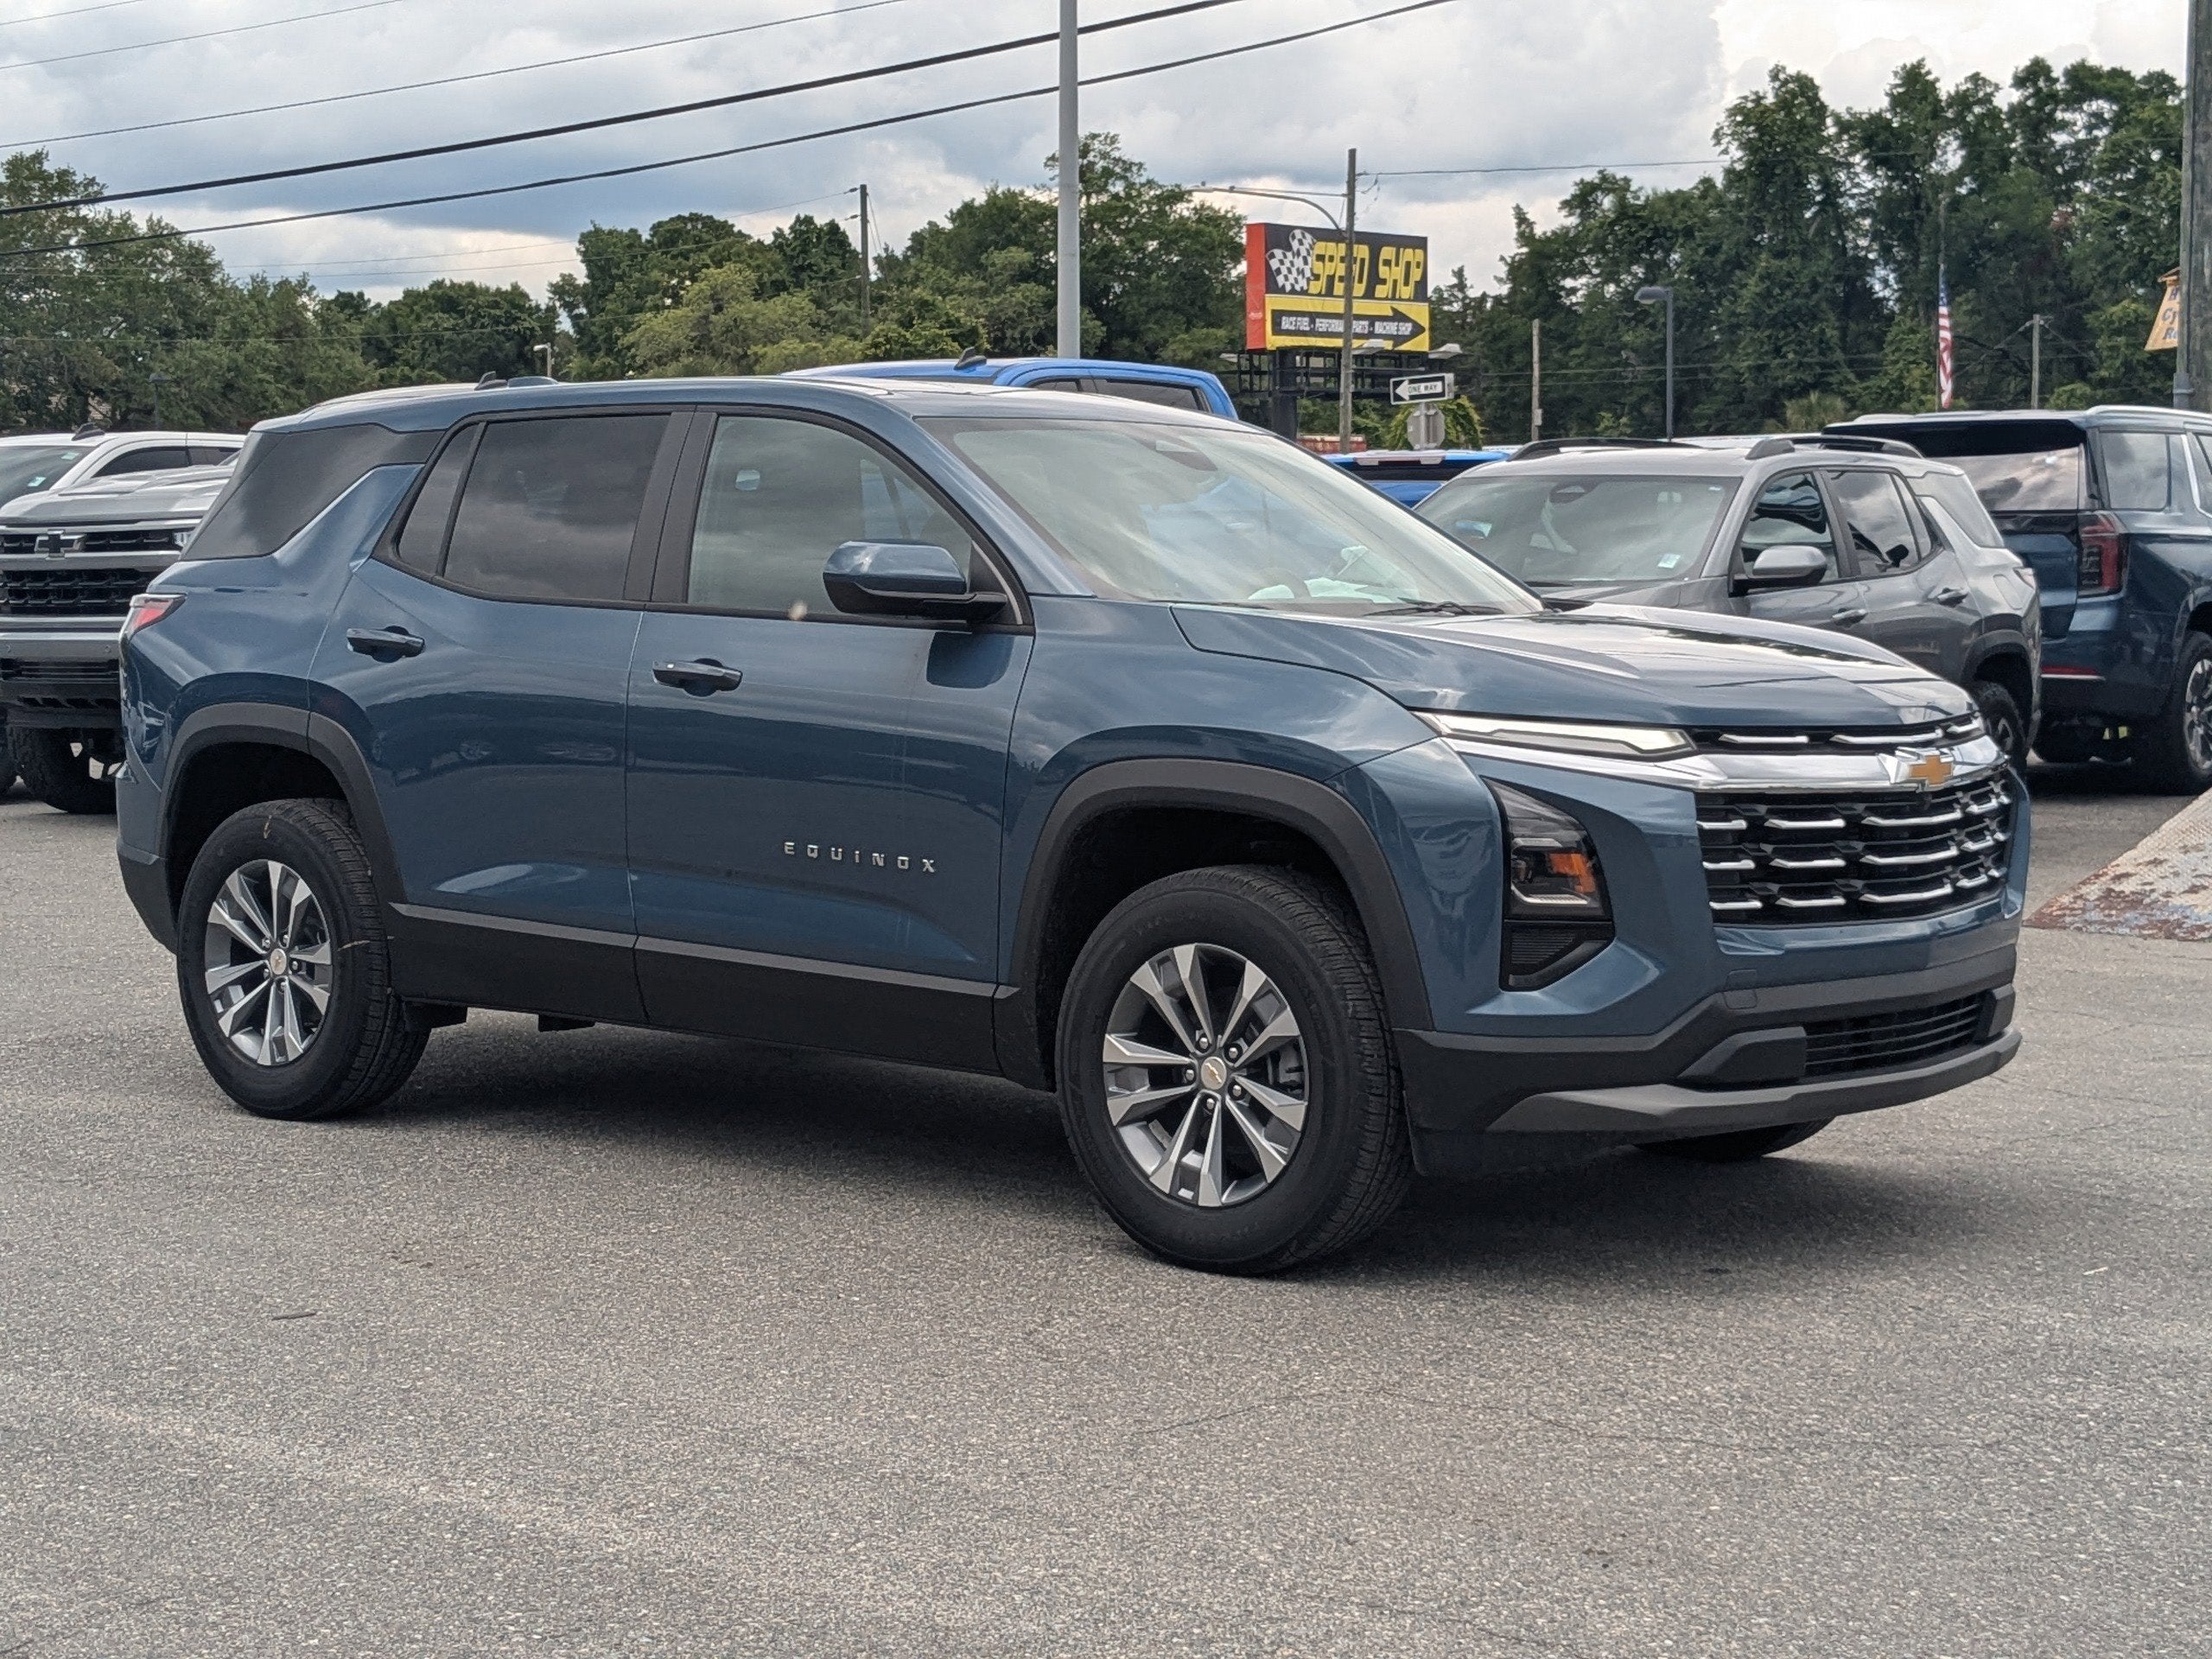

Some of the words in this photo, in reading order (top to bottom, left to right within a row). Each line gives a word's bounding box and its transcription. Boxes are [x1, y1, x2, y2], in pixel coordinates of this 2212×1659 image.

[1375, 246, 1424, 299] SHOP
[1409, 385, 1421, 393] ONE
[1423, 383, 1438, 391] WAY
[784, 842, 935, 873] EQUINOX
